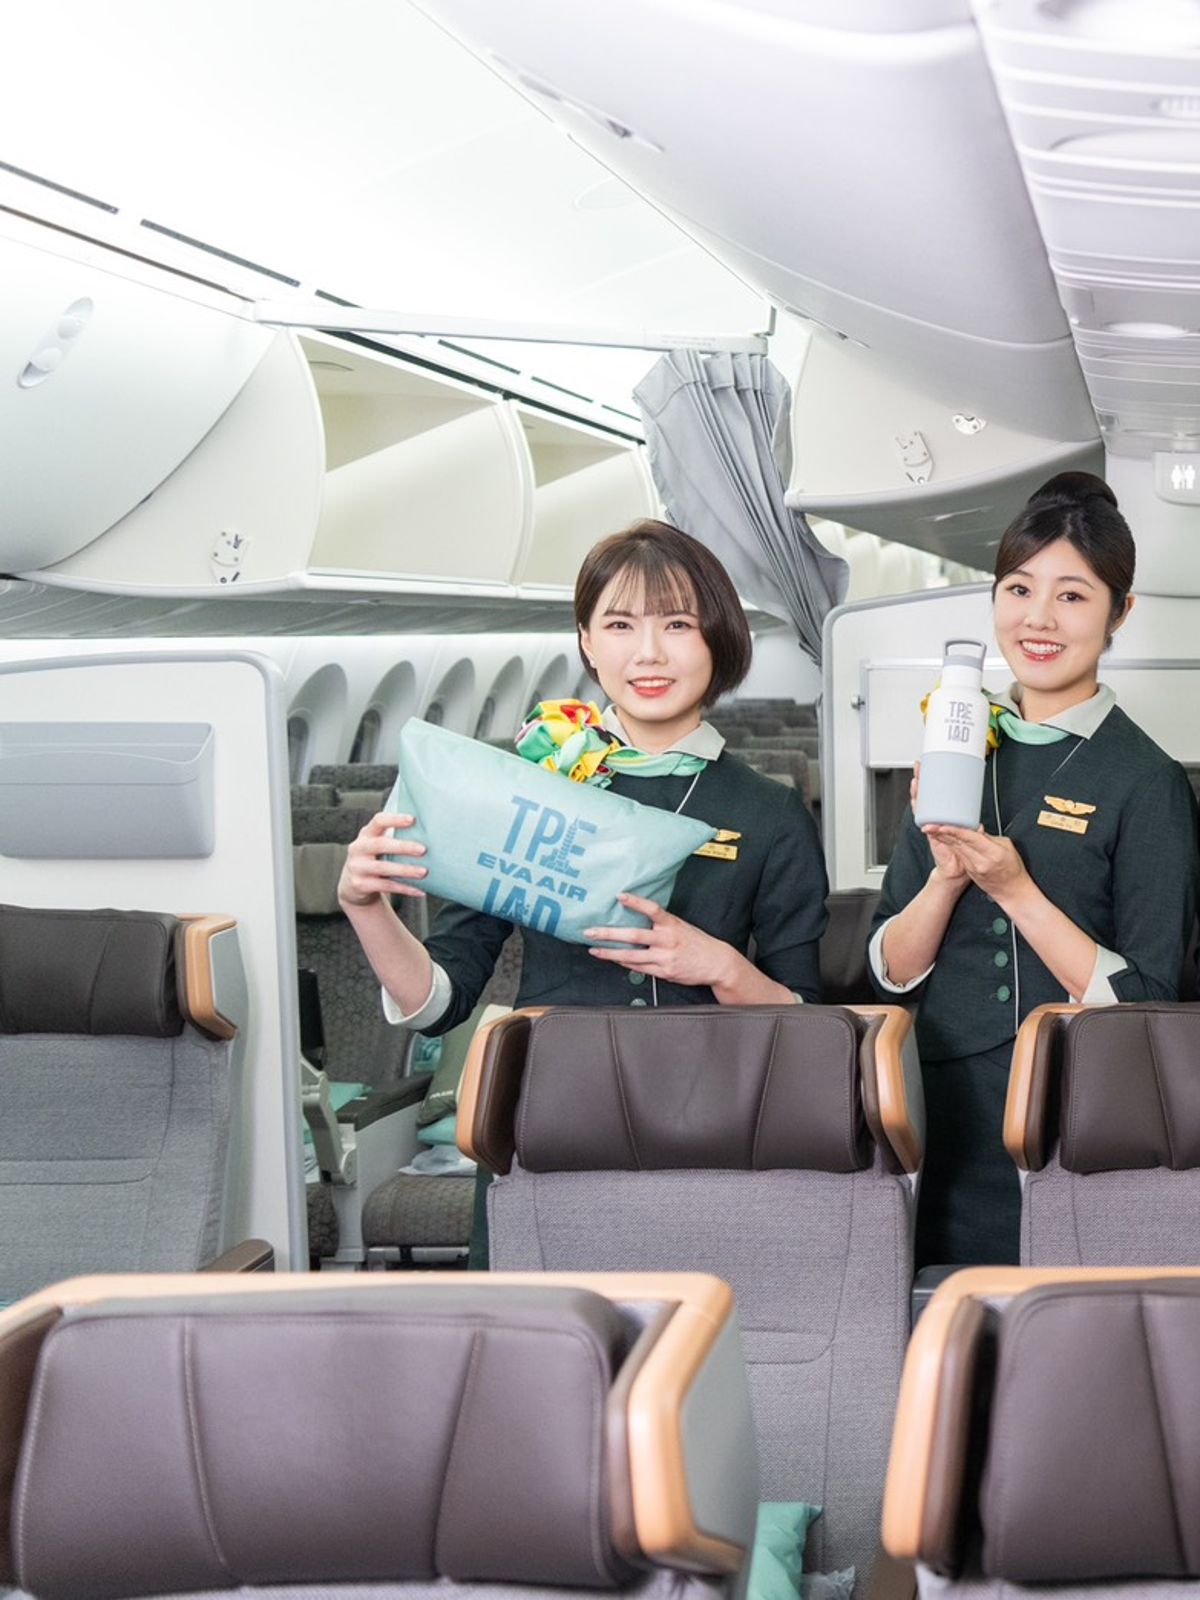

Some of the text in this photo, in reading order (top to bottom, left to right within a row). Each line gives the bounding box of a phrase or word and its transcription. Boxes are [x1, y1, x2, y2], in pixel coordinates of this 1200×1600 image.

[948, 725, 970, 742] IAD
[949, 701, 973, 720] TPE
[503, 796, 597, 878] TPE
[477, 852, 588, 902] EVA AIR
[482, 878, 562, 937] IAD
